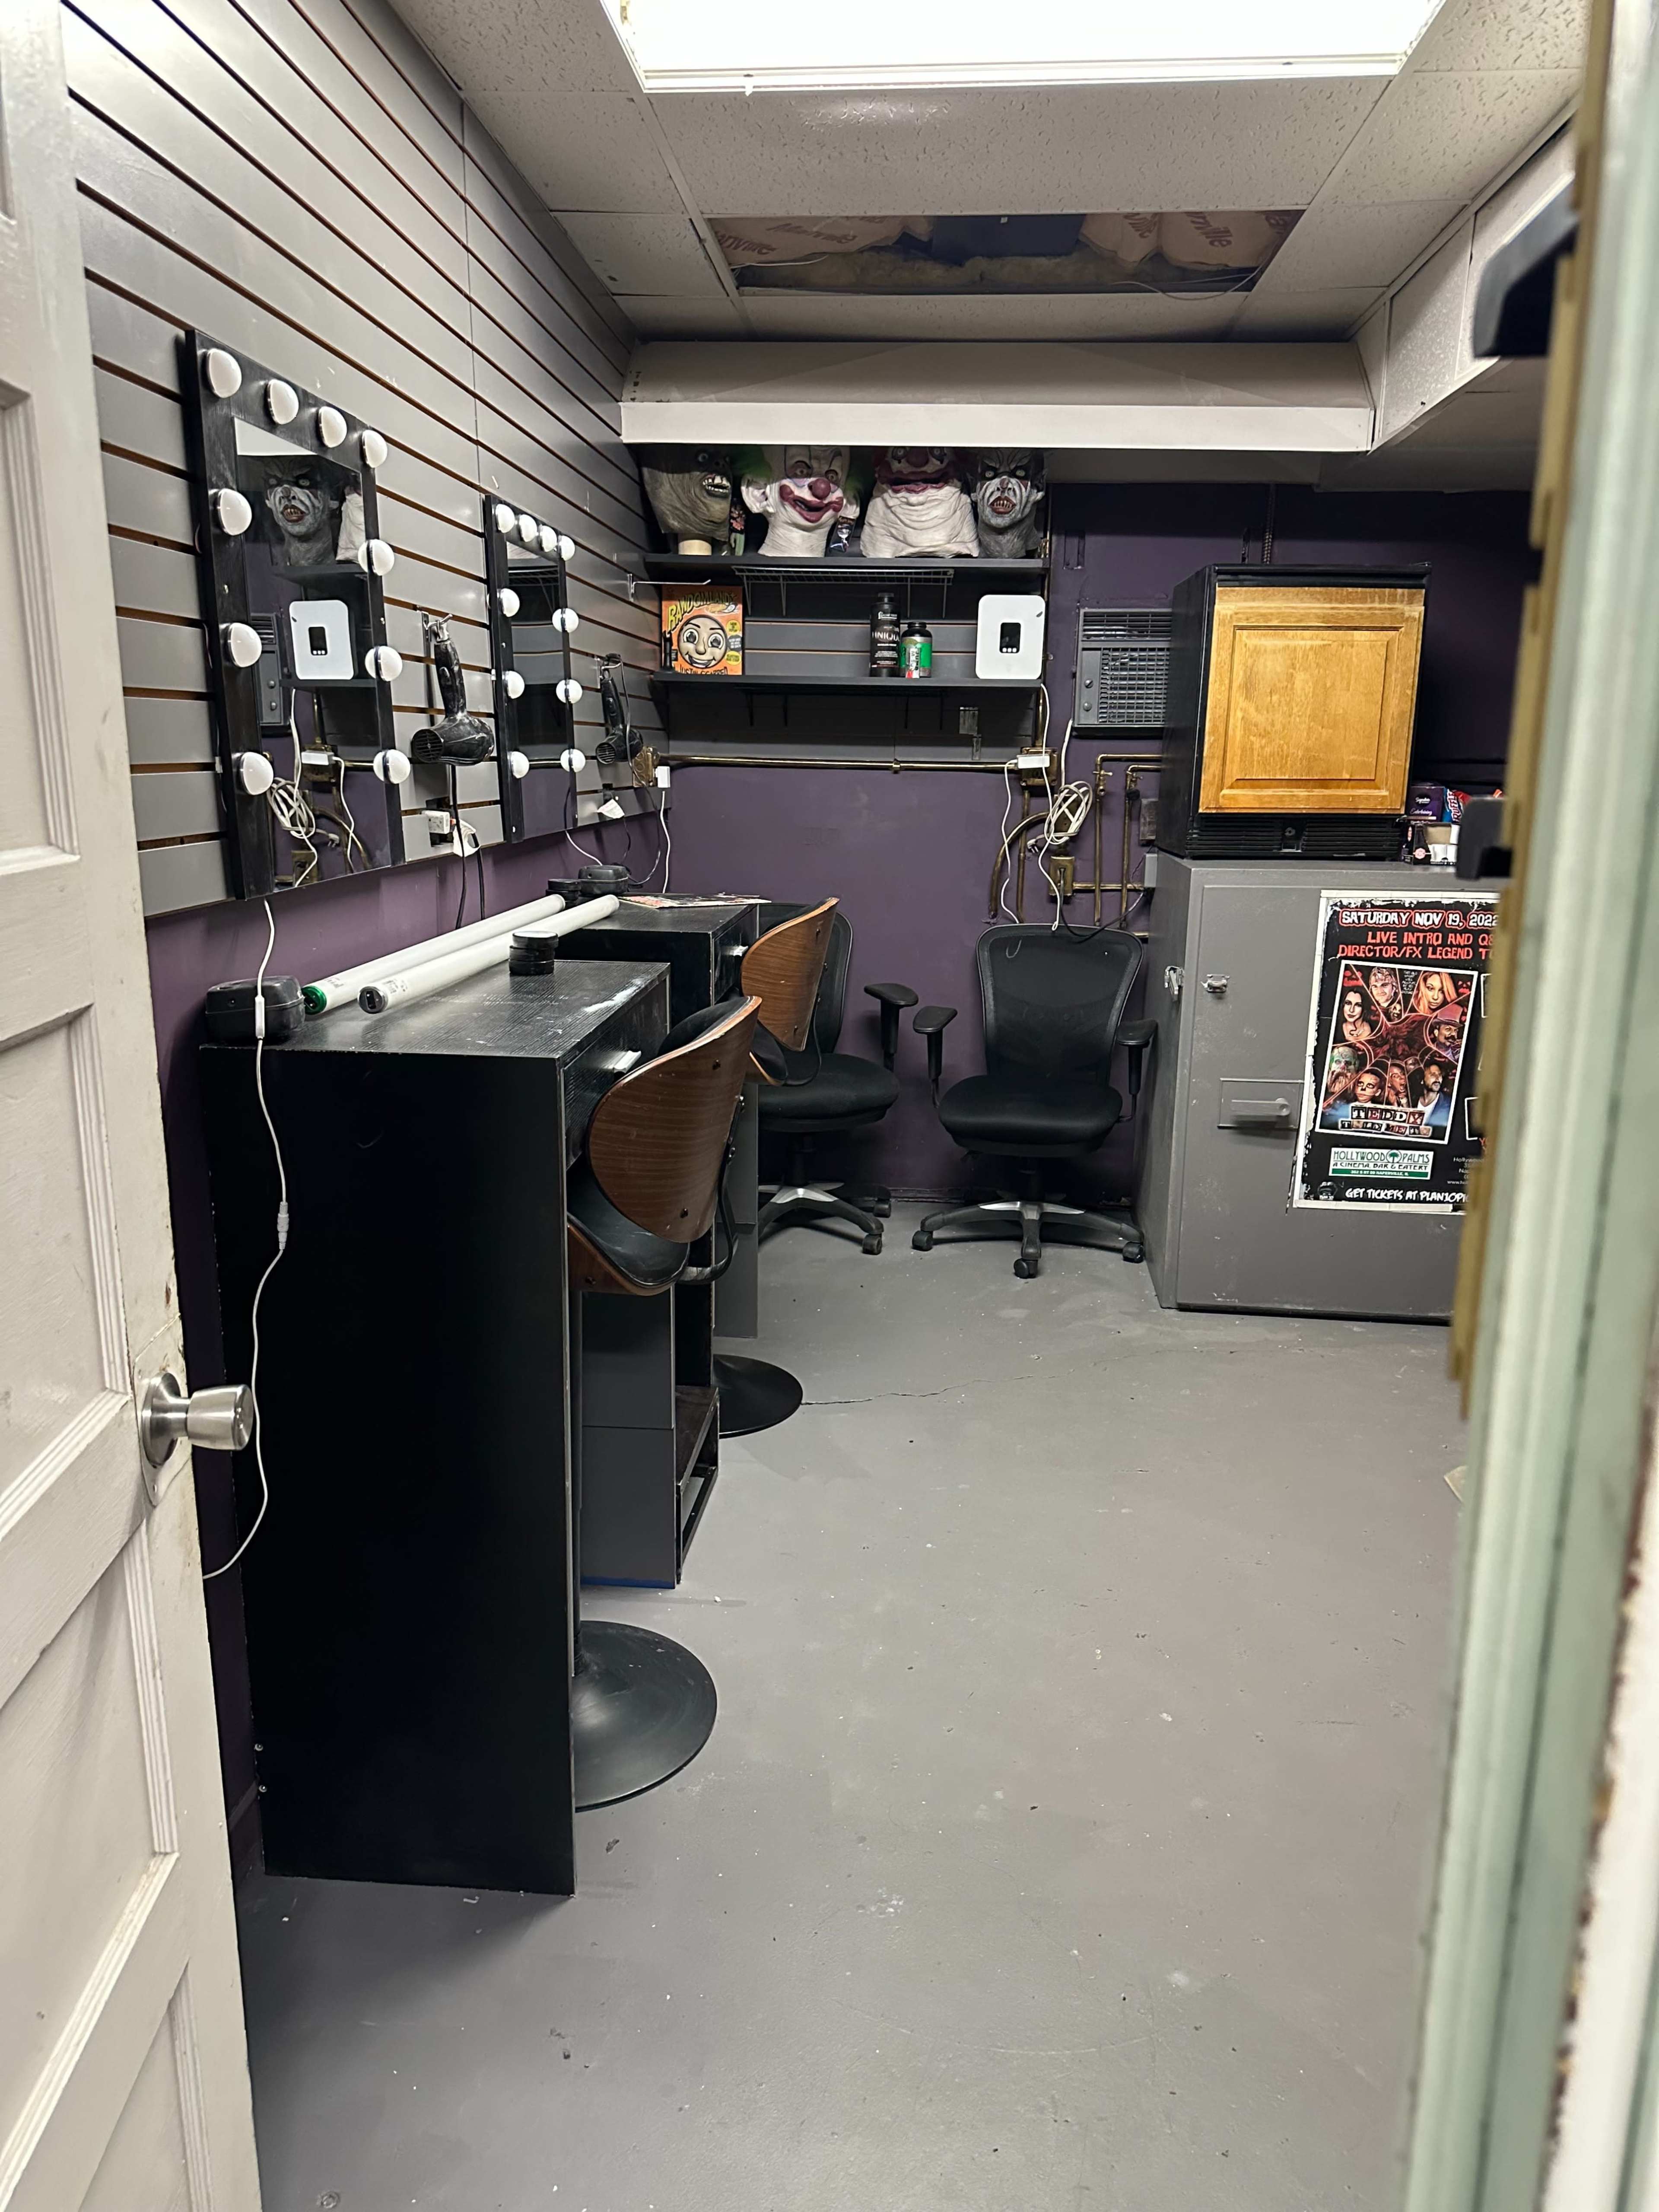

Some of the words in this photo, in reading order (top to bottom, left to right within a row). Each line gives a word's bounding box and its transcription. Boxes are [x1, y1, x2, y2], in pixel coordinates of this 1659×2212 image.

[1341, 911, 1410, 925] SATURDAY
[1414, 912, 1443, 926] NOV
[1448, 913, 1463, 927] 19,
[1469, 914, 1499, 926] 2022
[1367, 931, 1397, 944] LIVE
[1403, 932, 1442, 946] INTRO
[1447, 933, 1473, 946] AND
[1338, 944, 1423, 959] DIRECTOR/FX
[1427, 947, 1473, 960] LEGEND
[1351, 1106, 1425, 1125] TEDDY
[1333, 1150, 1385, 1161] HOLLYWOOD
[1402, 1153, 1430, 1163] PALMS
[1345, 1188, 1365, 1198] GET
[1366, 1189, 1404, 1201] TICKETS
[1405, 1191, 1418, 1201] AT
